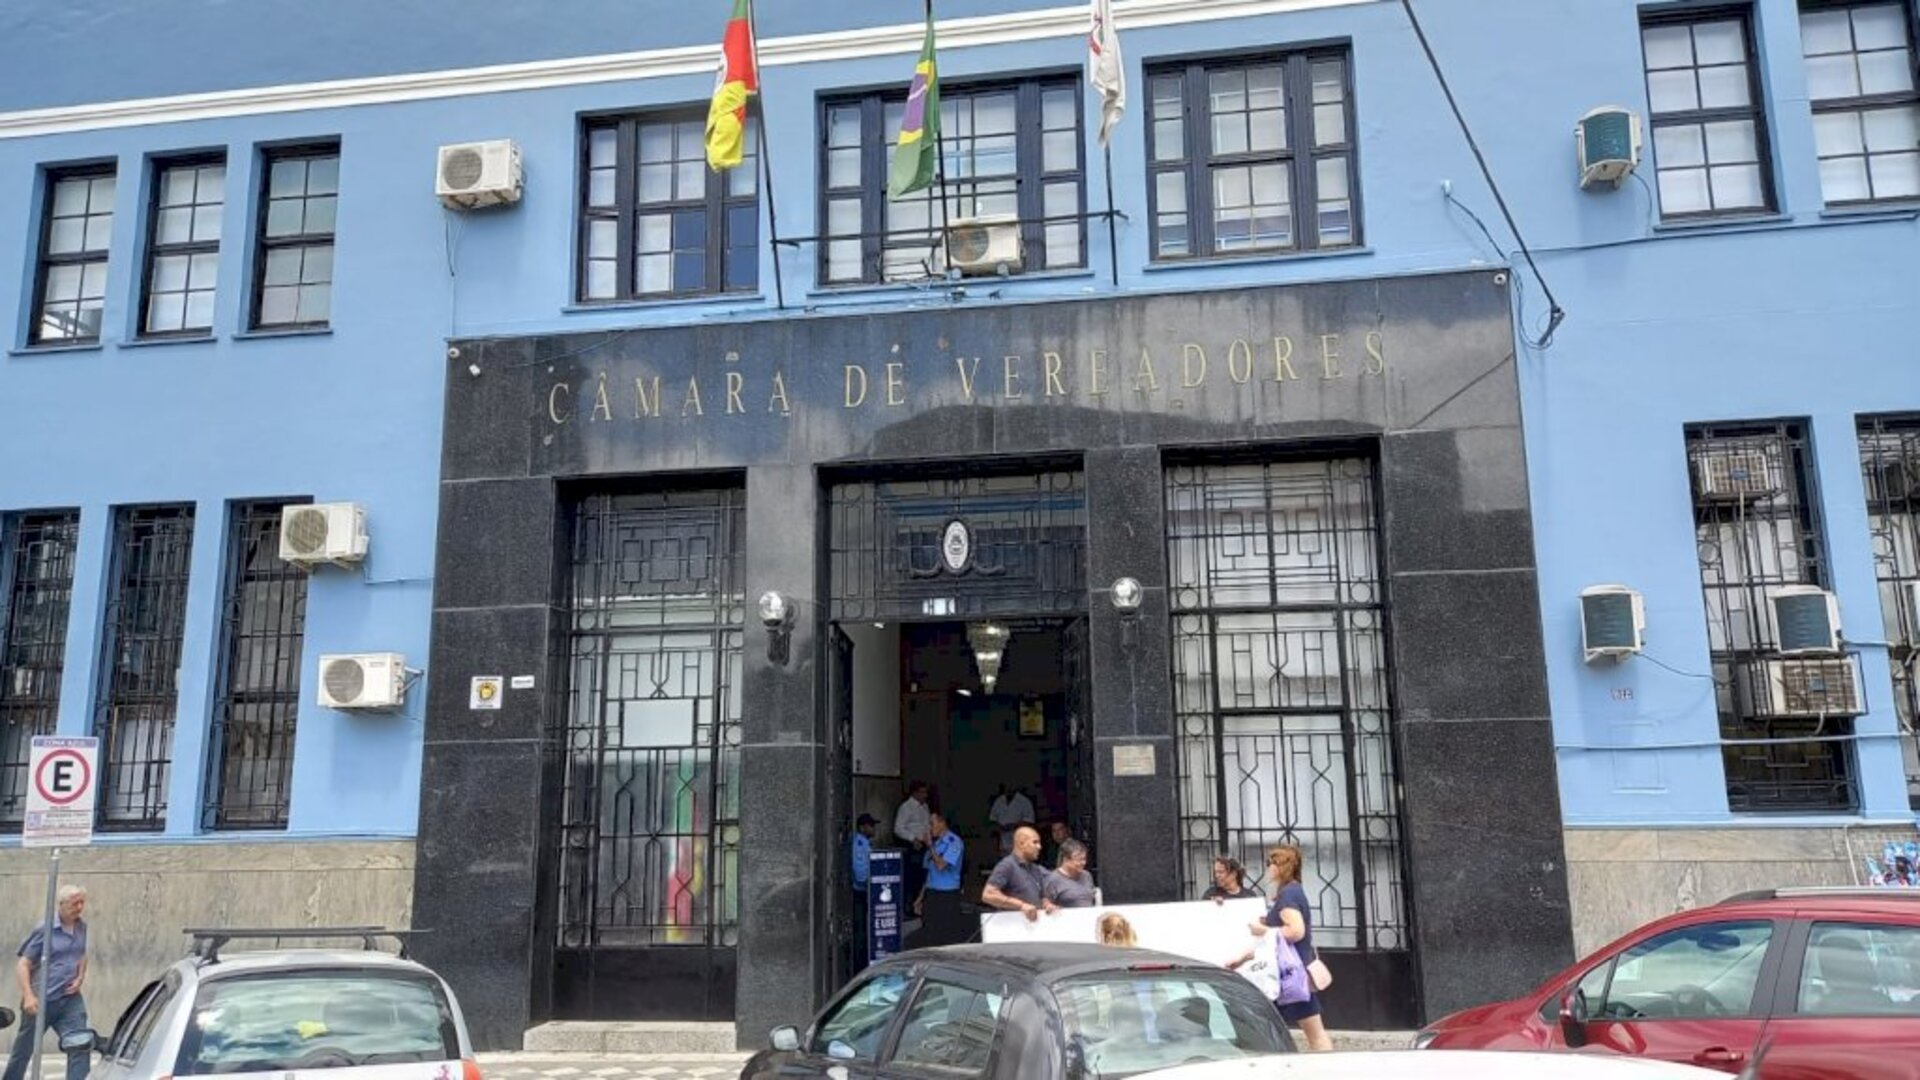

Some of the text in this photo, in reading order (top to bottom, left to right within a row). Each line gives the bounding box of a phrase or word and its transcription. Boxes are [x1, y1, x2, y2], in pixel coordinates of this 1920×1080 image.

[550, 331, 1385, 425] CÂMARA DE VEREADORES
[53, 761, 73, 791] E
